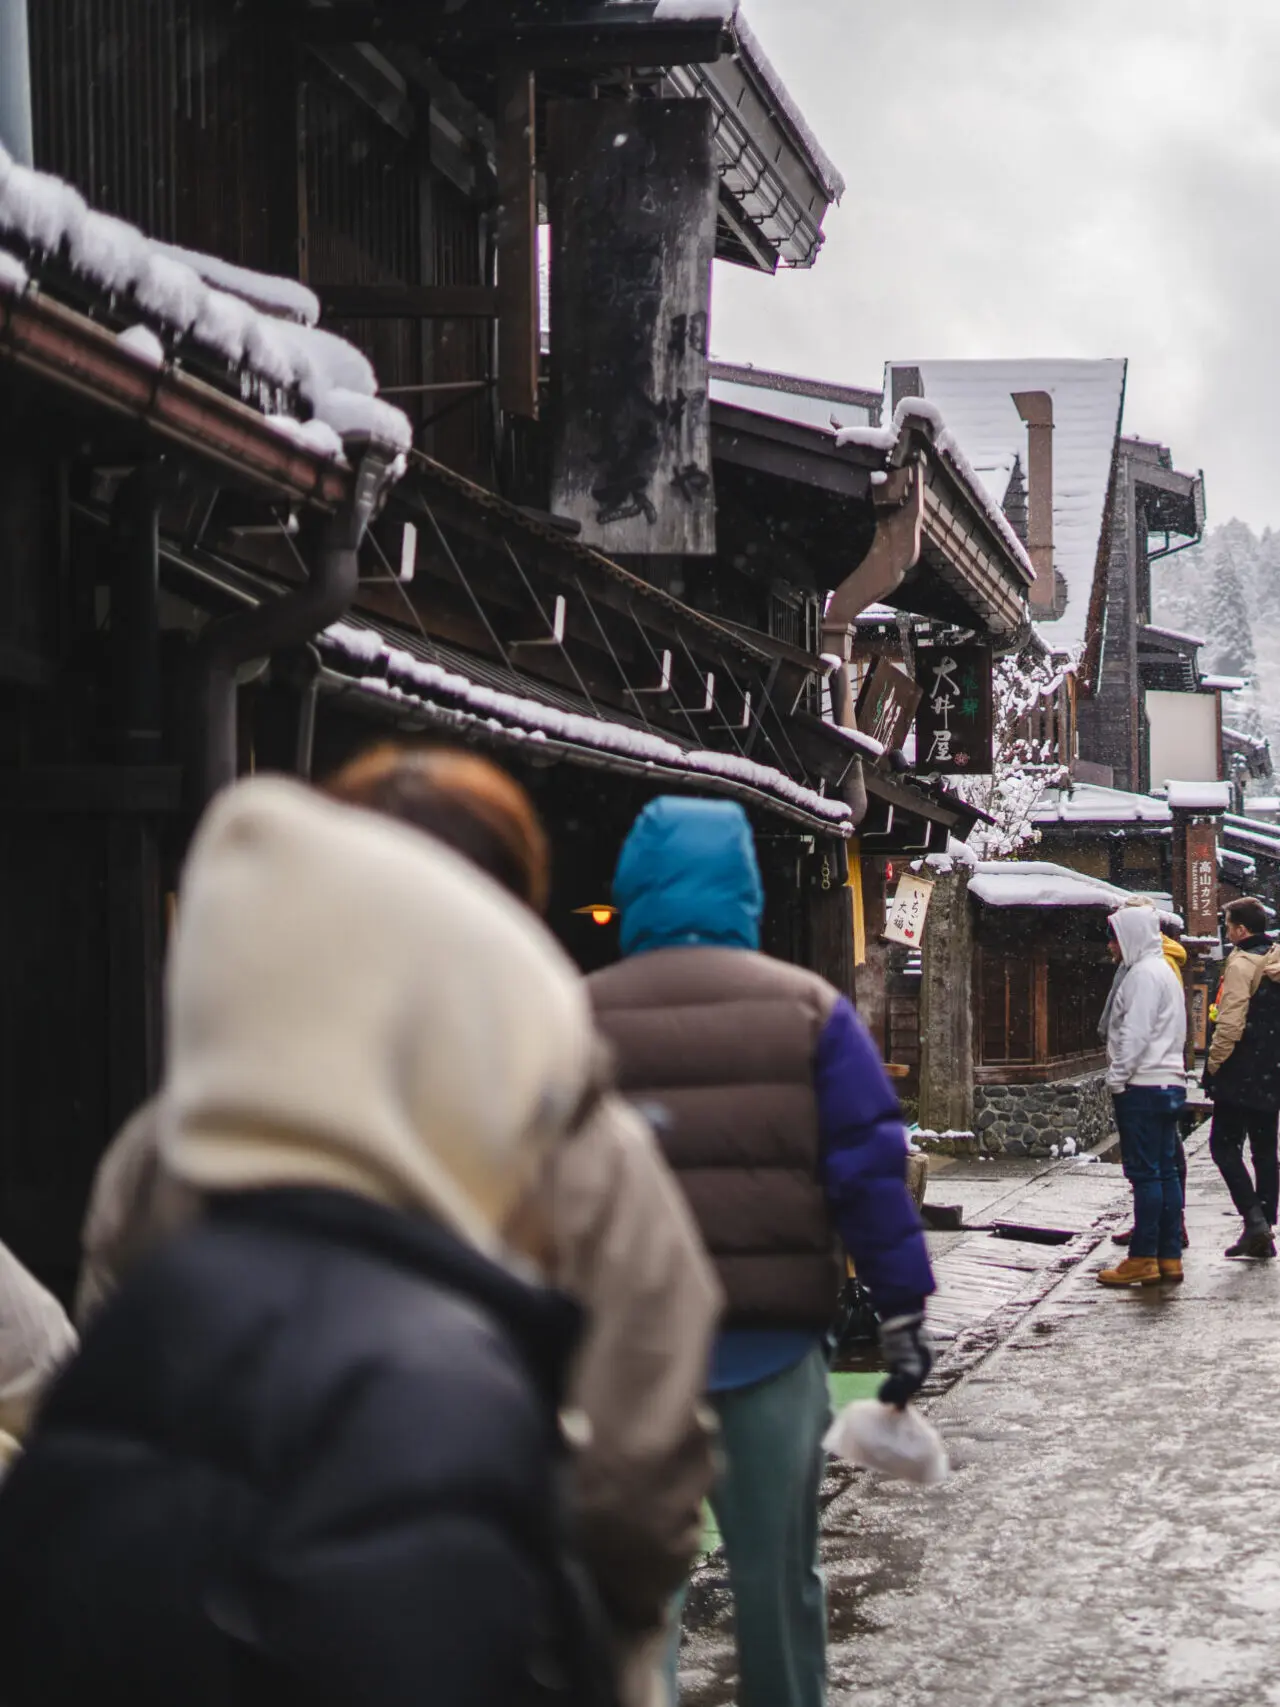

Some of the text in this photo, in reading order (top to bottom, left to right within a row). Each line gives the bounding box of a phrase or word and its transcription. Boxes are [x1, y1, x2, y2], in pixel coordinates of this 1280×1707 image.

[925, 655, 961, 763] 大井屋
[908, 889, 925, 927] いちご
[1199, 860, 1212, 916] 高山カフェ
[893, 900, 908, 930] 大福
